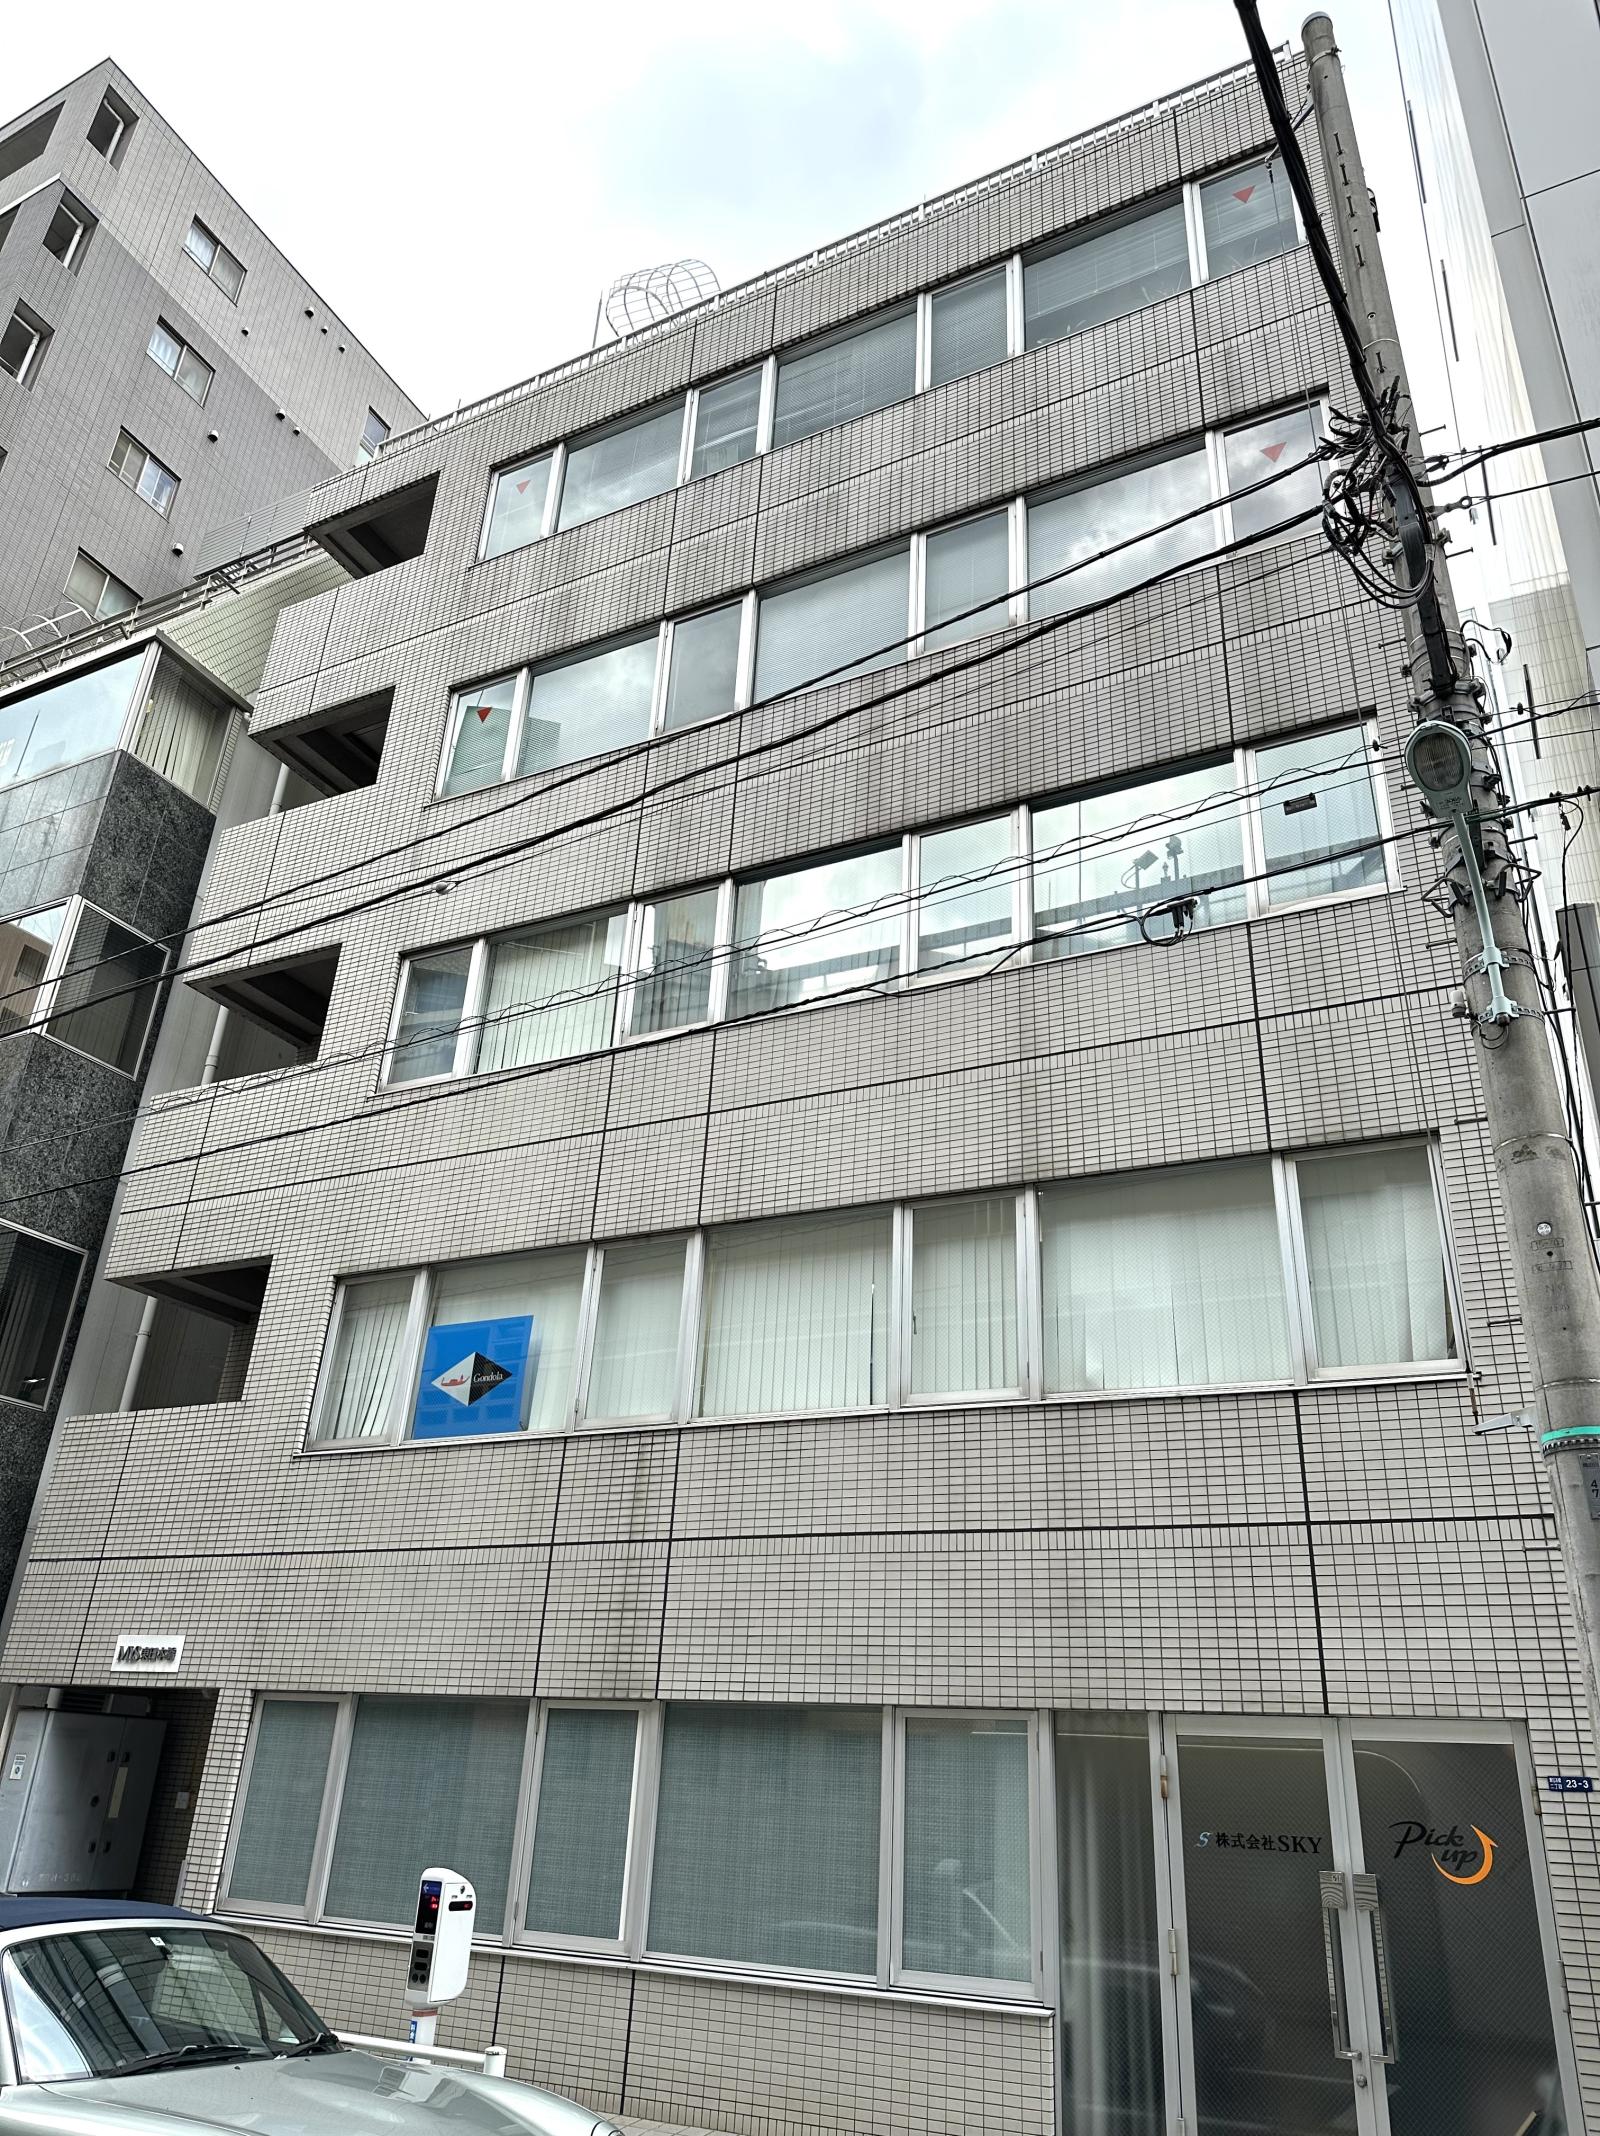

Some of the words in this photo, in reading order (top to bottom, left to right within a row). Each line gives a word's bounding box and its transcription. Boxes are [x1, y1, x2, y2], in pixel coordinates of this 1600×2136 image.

[473, 1371, 503, 1383] Gondola
[1566, 1779, 1589, 1789] 23-3
[1216, 1832, 1323, 1854] 株式会社SKY
[1388, 1820, 1464, 1859] Pick
[1441, 1849, 1478, 1872] up
